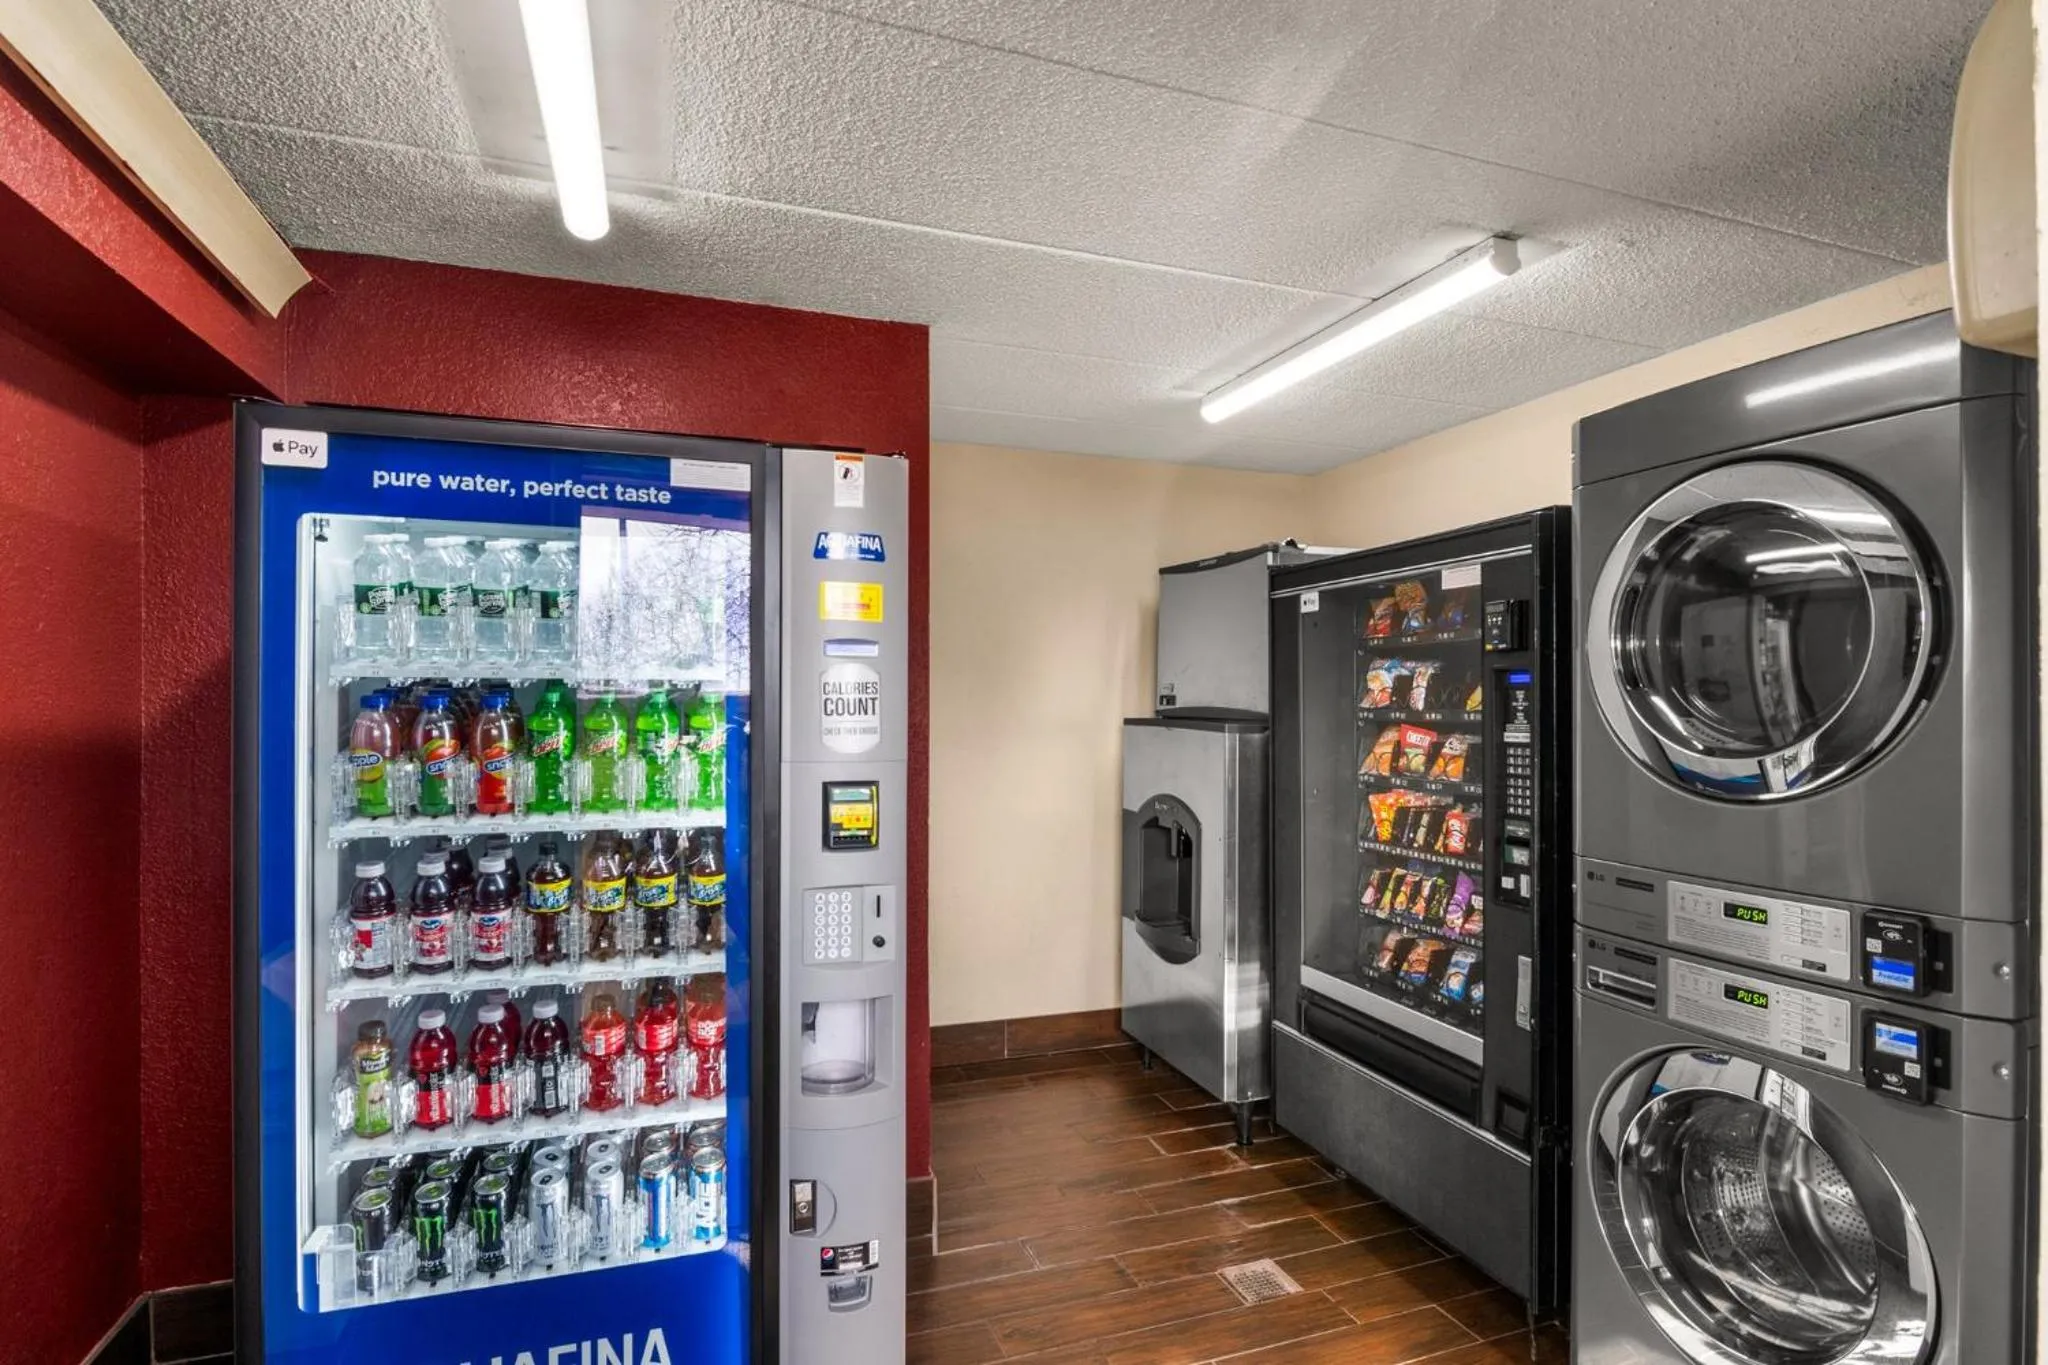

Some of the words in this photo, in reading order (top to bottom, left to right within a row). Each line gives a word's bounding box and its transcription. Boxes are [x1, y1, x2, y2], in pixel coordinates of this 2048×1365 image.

[288, 440, 318, 458] Pay
[373, 470, 432, 489] pure
[439, 473, 516, 497] water,
[523, 479, 609, 500] perfect
[615, 483, 672, 505] taste
[818, 534, 883, 553] AAFINA
[822, 681, 879, 696] CALORIES
[823, 697, 879, 717] COUNT
[1737, 907, 1767, 922] PUSH
[1737, 990, 1768, 1006] PUSH
